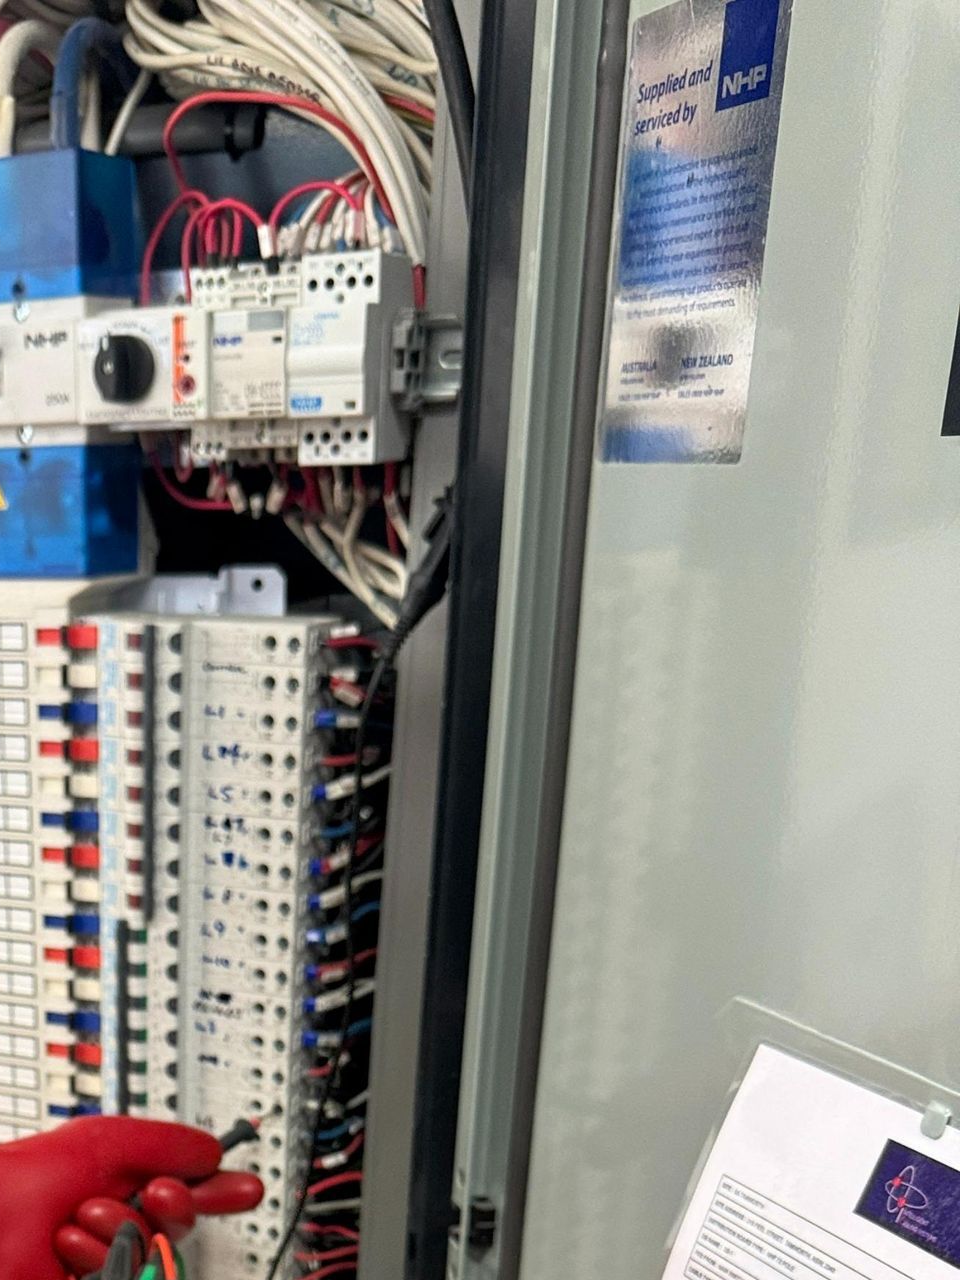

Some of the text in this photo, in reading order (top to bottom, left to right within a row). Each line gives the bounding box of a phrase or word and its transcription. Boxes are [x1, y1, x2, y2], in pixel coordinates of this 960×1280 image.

[638, 60, 713, 104] Supplied and
[722, 64, 767, 99] NHP
[635, 101, 697, 136] serviced by
[24, 331, 67, 349] NHP
[681, 358, 698, 369] NEW
[699, 354, 733, 368] ZEALAND
